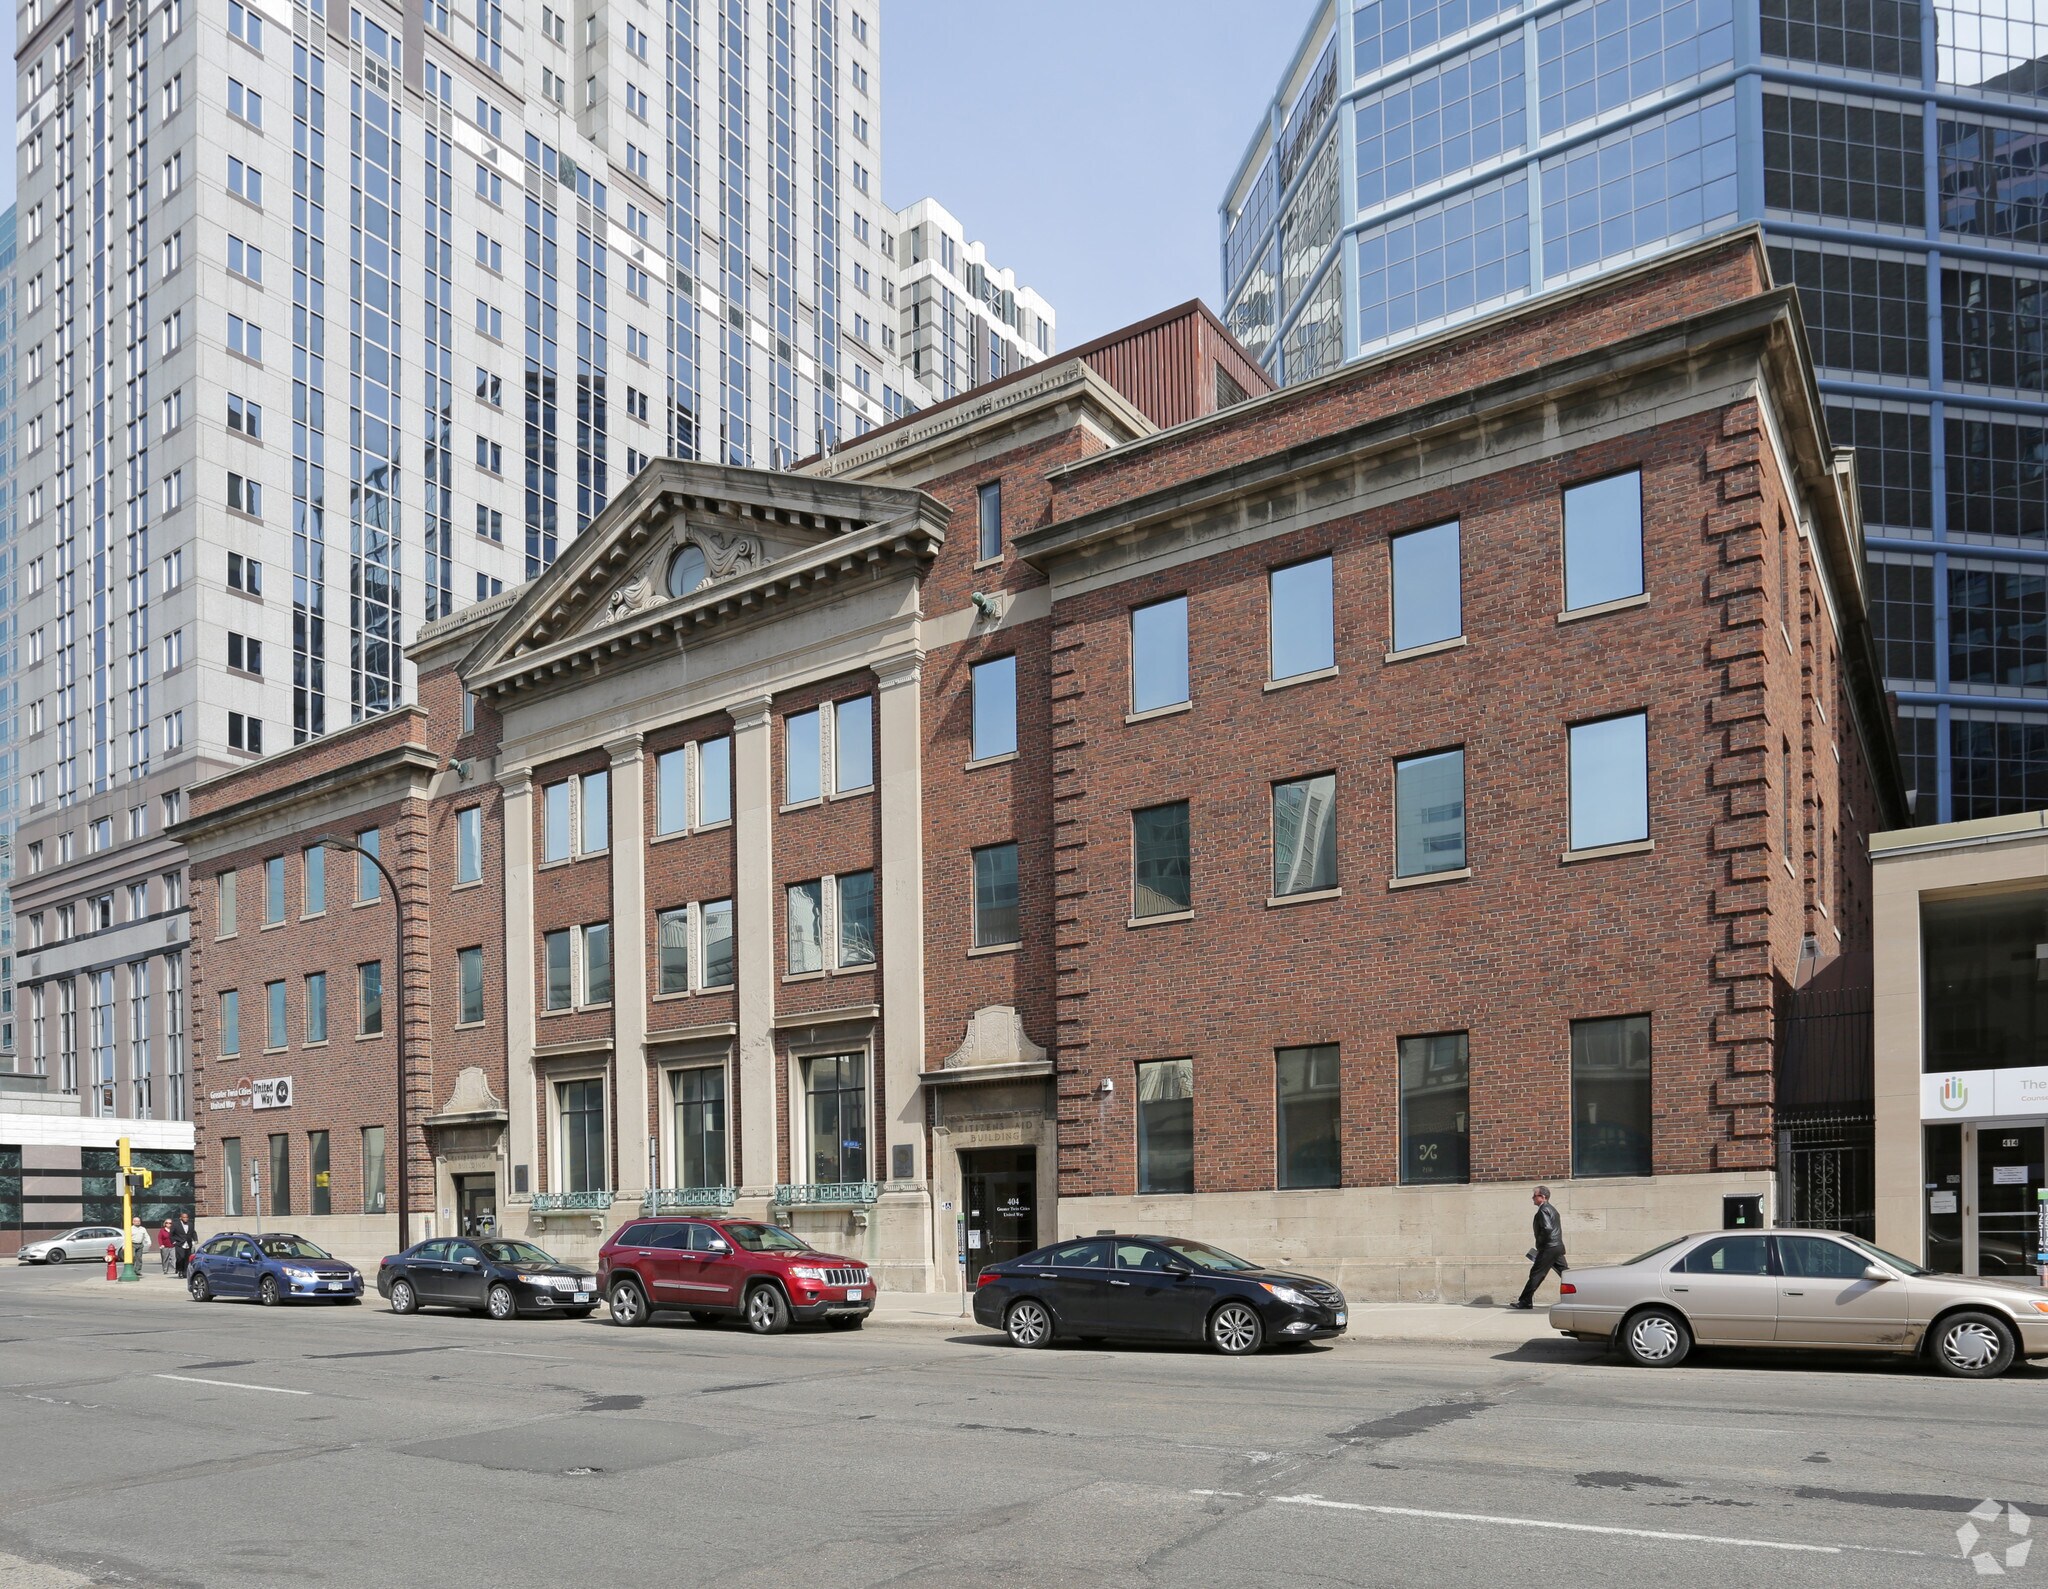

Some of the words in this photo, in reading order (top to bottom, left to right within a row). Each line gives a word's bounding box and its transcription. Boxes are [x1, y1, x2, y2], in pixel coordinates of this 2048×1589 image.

[254, 1082, 273, 1094] United
[2020, 1080, 2047, 1089] The
[238, 1087, 252, 1096] Cities
[261, 1094, 273, 1106] Way
[958, 1123, 1004, 1133] CITIZENS
[1015, 1121, 1032, 1130] AID
[971, 1132, 1019, 1142] BUILDING
[2003, 1139, 2018, 1147] 414
